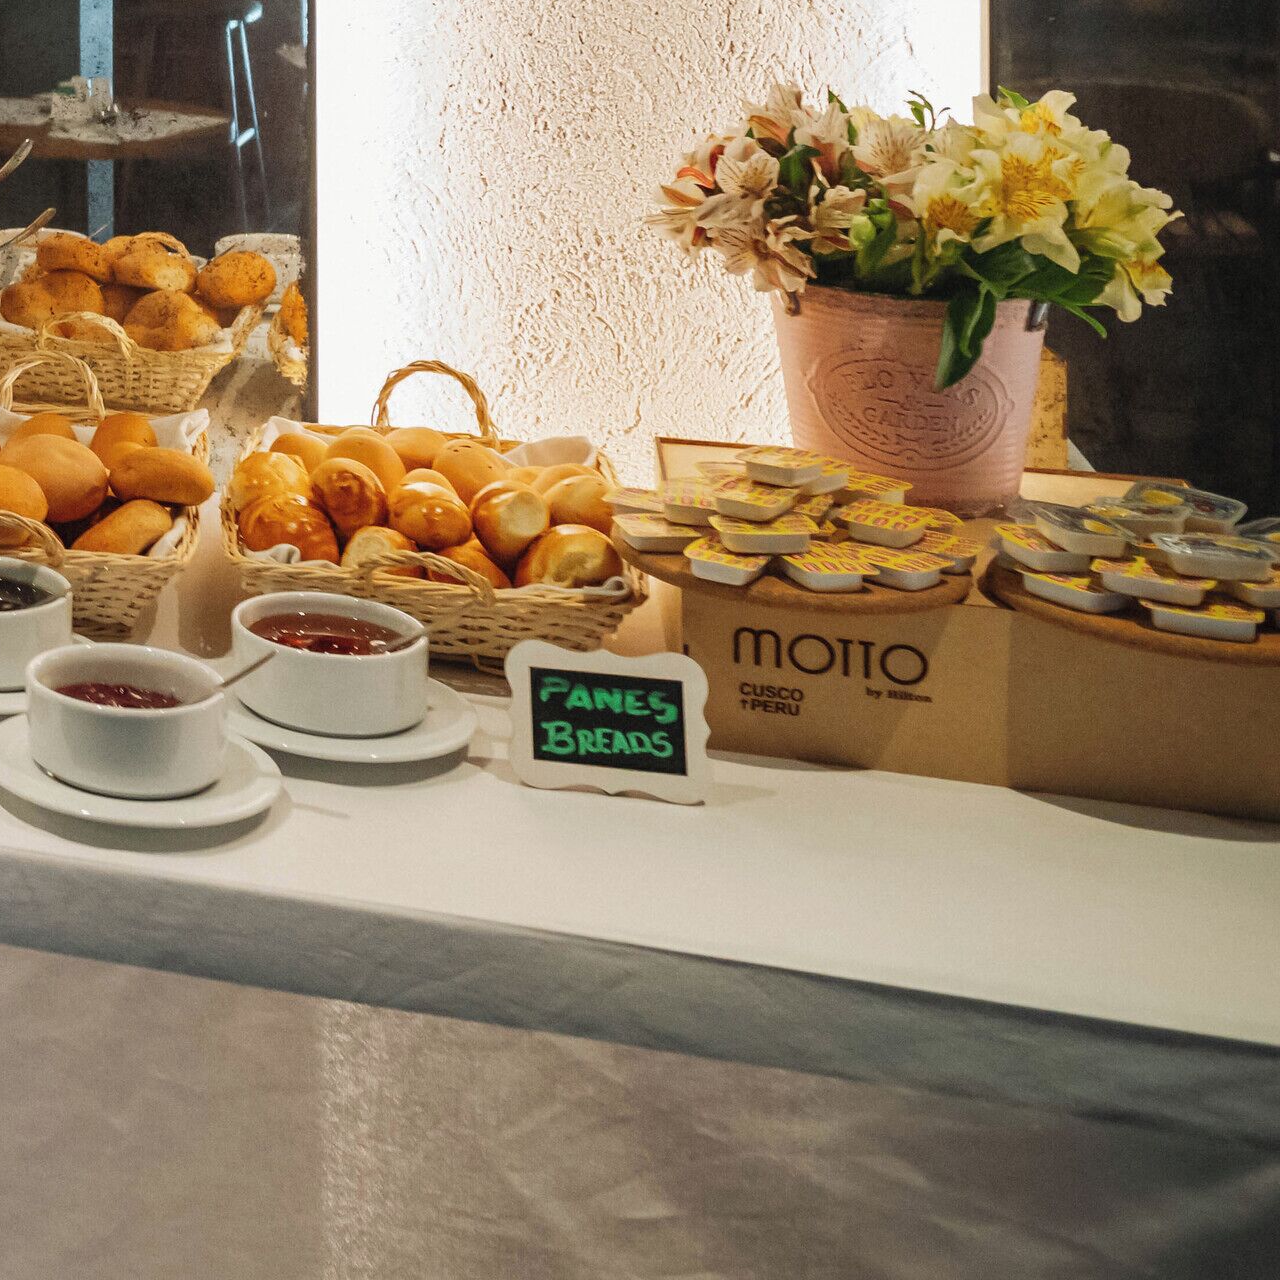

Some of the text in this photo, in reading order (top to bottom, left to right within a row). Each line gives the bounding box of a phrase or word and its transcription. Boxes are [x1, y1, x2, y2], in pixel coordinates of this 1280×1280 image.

[863, 406, 958, 433] GARDEN
[540, 676, 679, 724] PANES
[739, 681, 805, 703] CUSCO
[865, 685, 883, 700] by
[749, 698, 802, 717] PERU
[541, 720, 674, 759] BREADS
